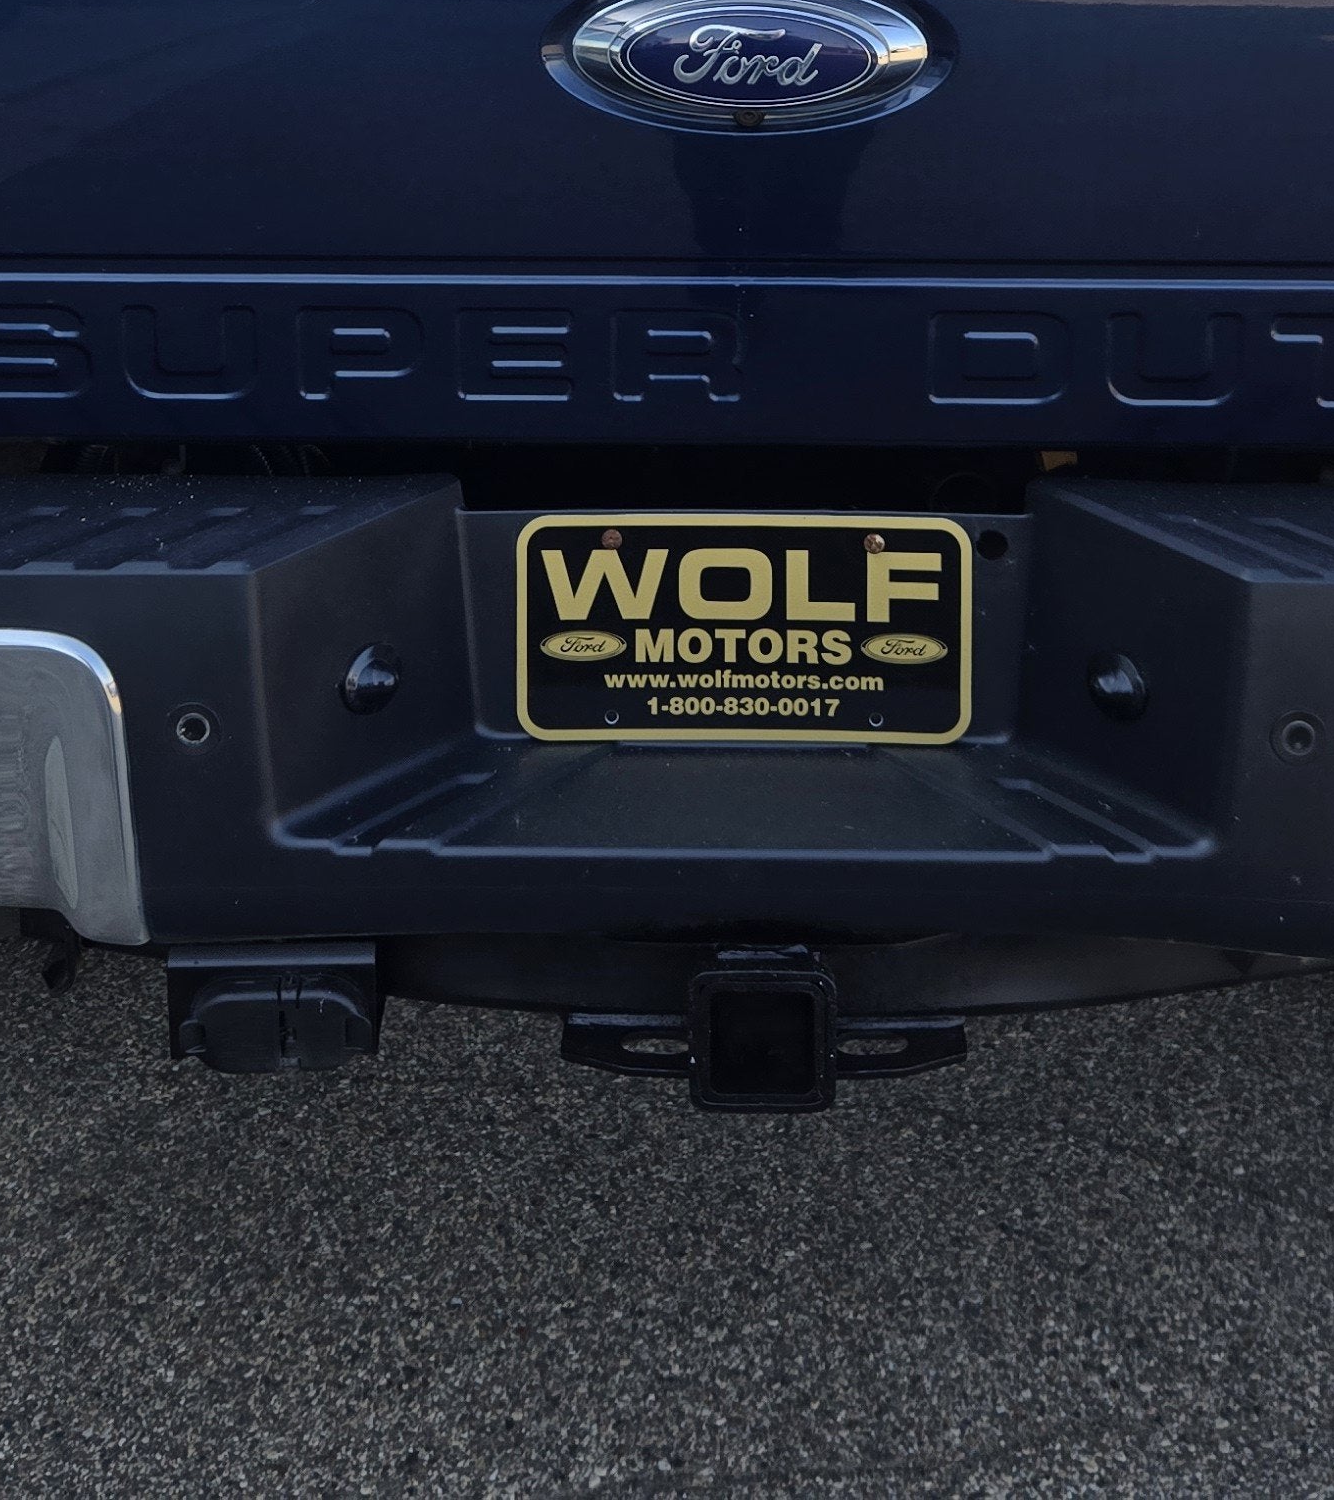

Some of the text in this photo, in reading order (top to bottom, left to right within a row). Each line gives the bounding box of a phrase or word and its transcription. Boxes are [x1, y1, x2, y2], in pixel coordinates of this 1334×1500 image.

[673, 22, 824, 88] Ford
[540, 548, 943, 623] WOLF
[560, 634, 607, 656] Ford
[635, 628, 853, 665] MOTORS
[879, 637, 927, 658] Ford
[603, 669, 885, 691] www.wolfmotors.com
[647, 696, 841, 718] 1-800-830-0017
